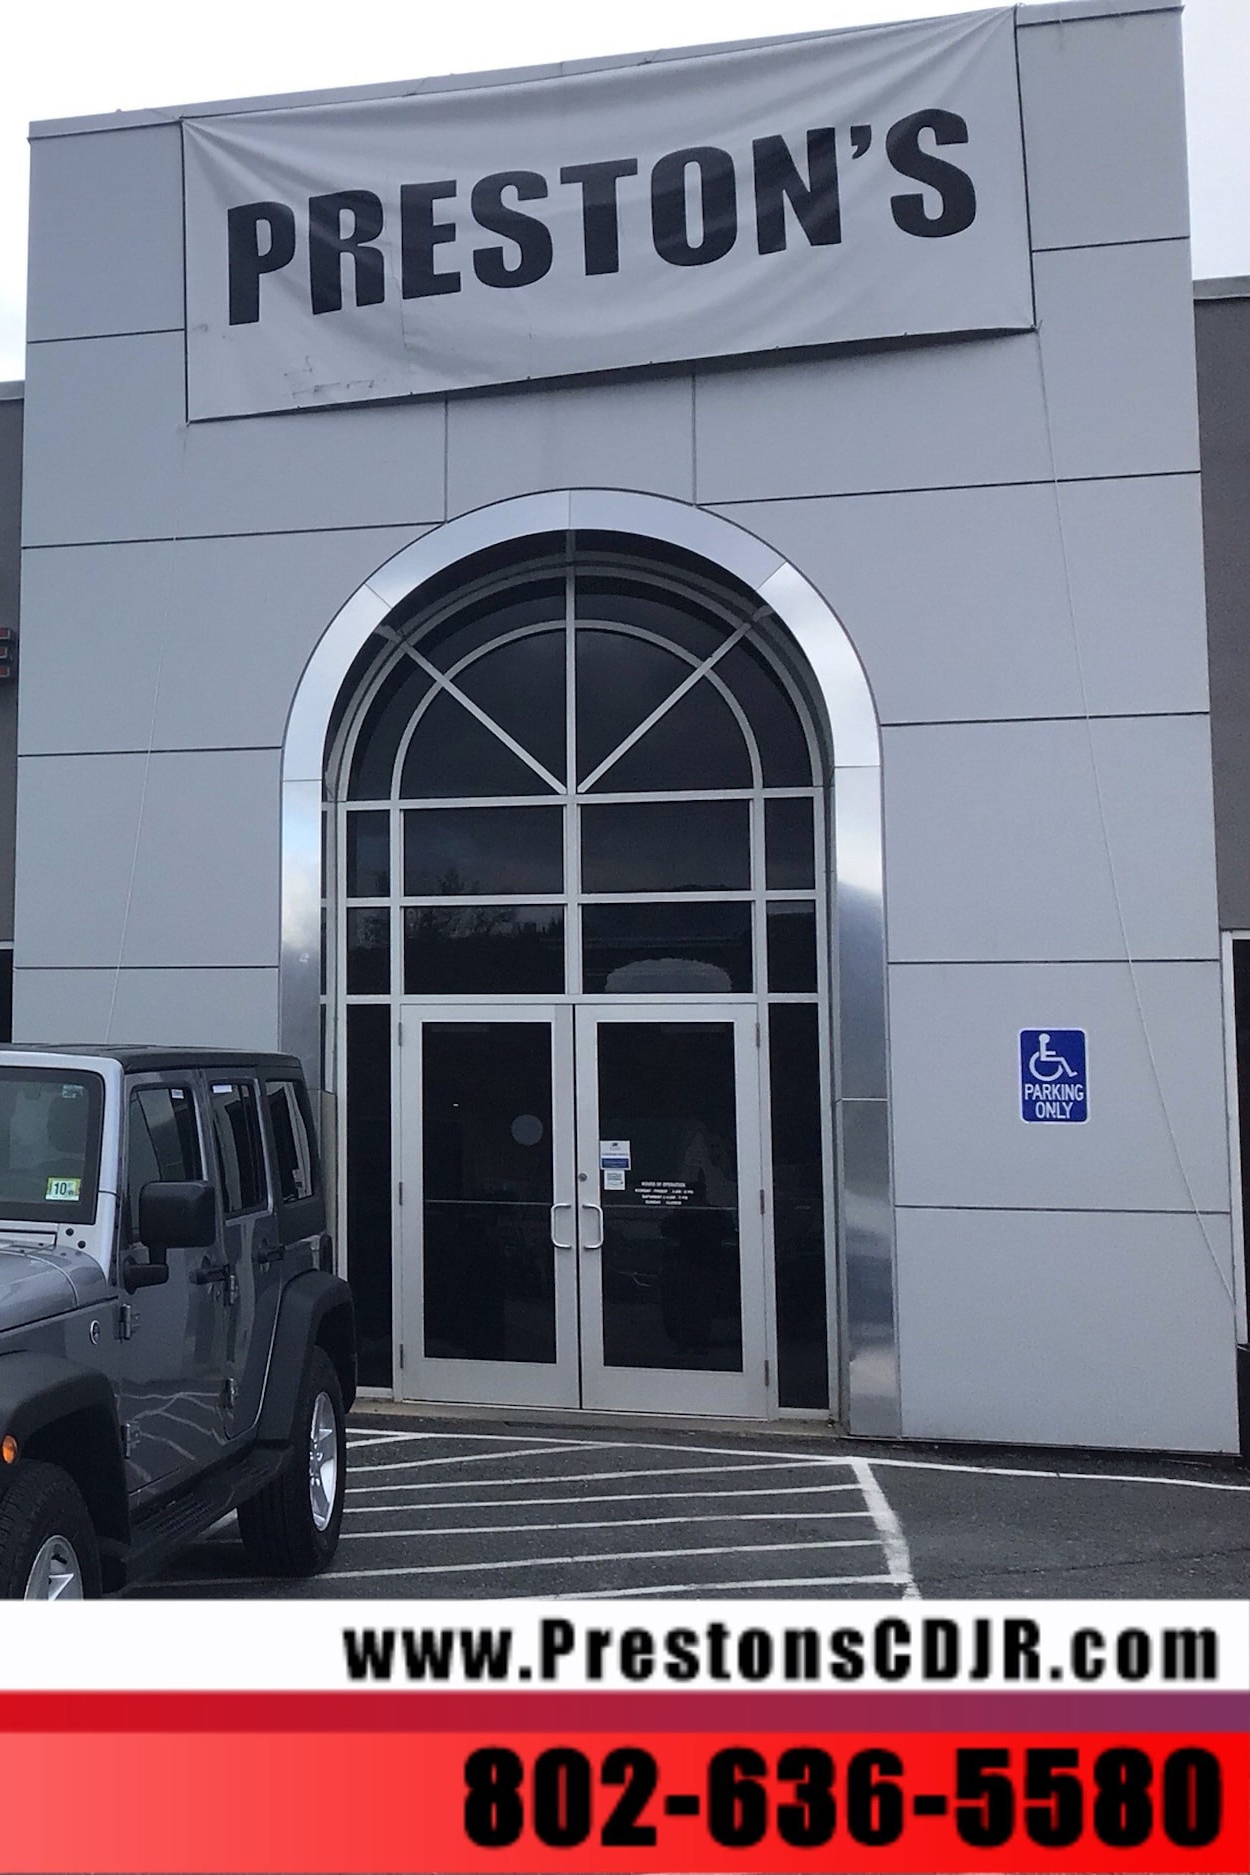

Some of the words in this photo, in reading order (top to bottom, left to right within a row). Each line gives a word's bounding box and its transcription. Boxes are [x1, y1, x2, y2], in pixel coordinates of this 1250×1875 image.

[227, 108, 976, 326] PRESTON'S
[1024, 1083, 1084, 1101] PARKING
[1035, 1101, 1073, 1119] ONLY
[54, 1182, 67, 1196] 10
